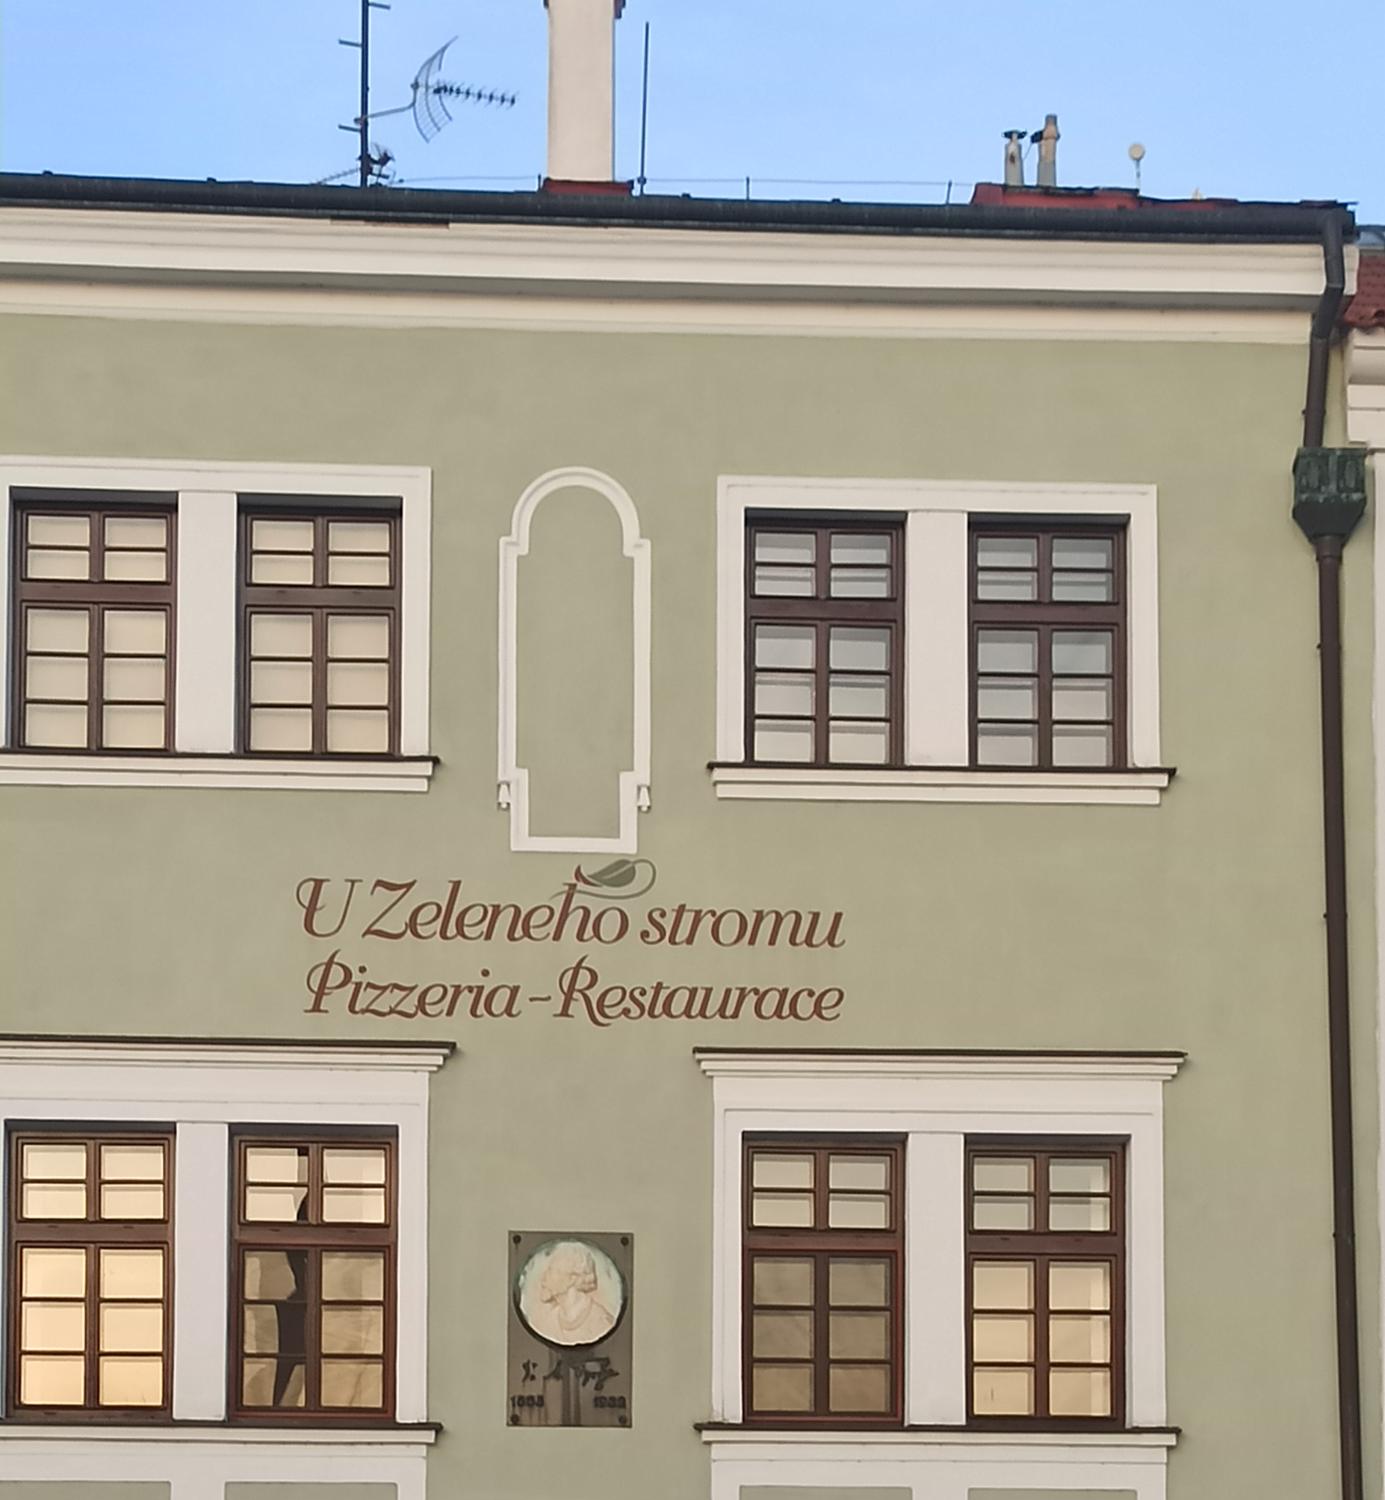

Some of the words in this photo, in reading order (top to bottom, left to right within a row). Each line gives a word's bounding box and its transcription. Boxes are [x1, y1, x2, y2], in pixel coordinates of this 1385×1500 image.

[296, 877, 363, 939] U
[639, 903, 846, 949] stromu
[303, 949, 522, 1019] Pizzeria
[552, 955, 845, 1028] Restaurace
